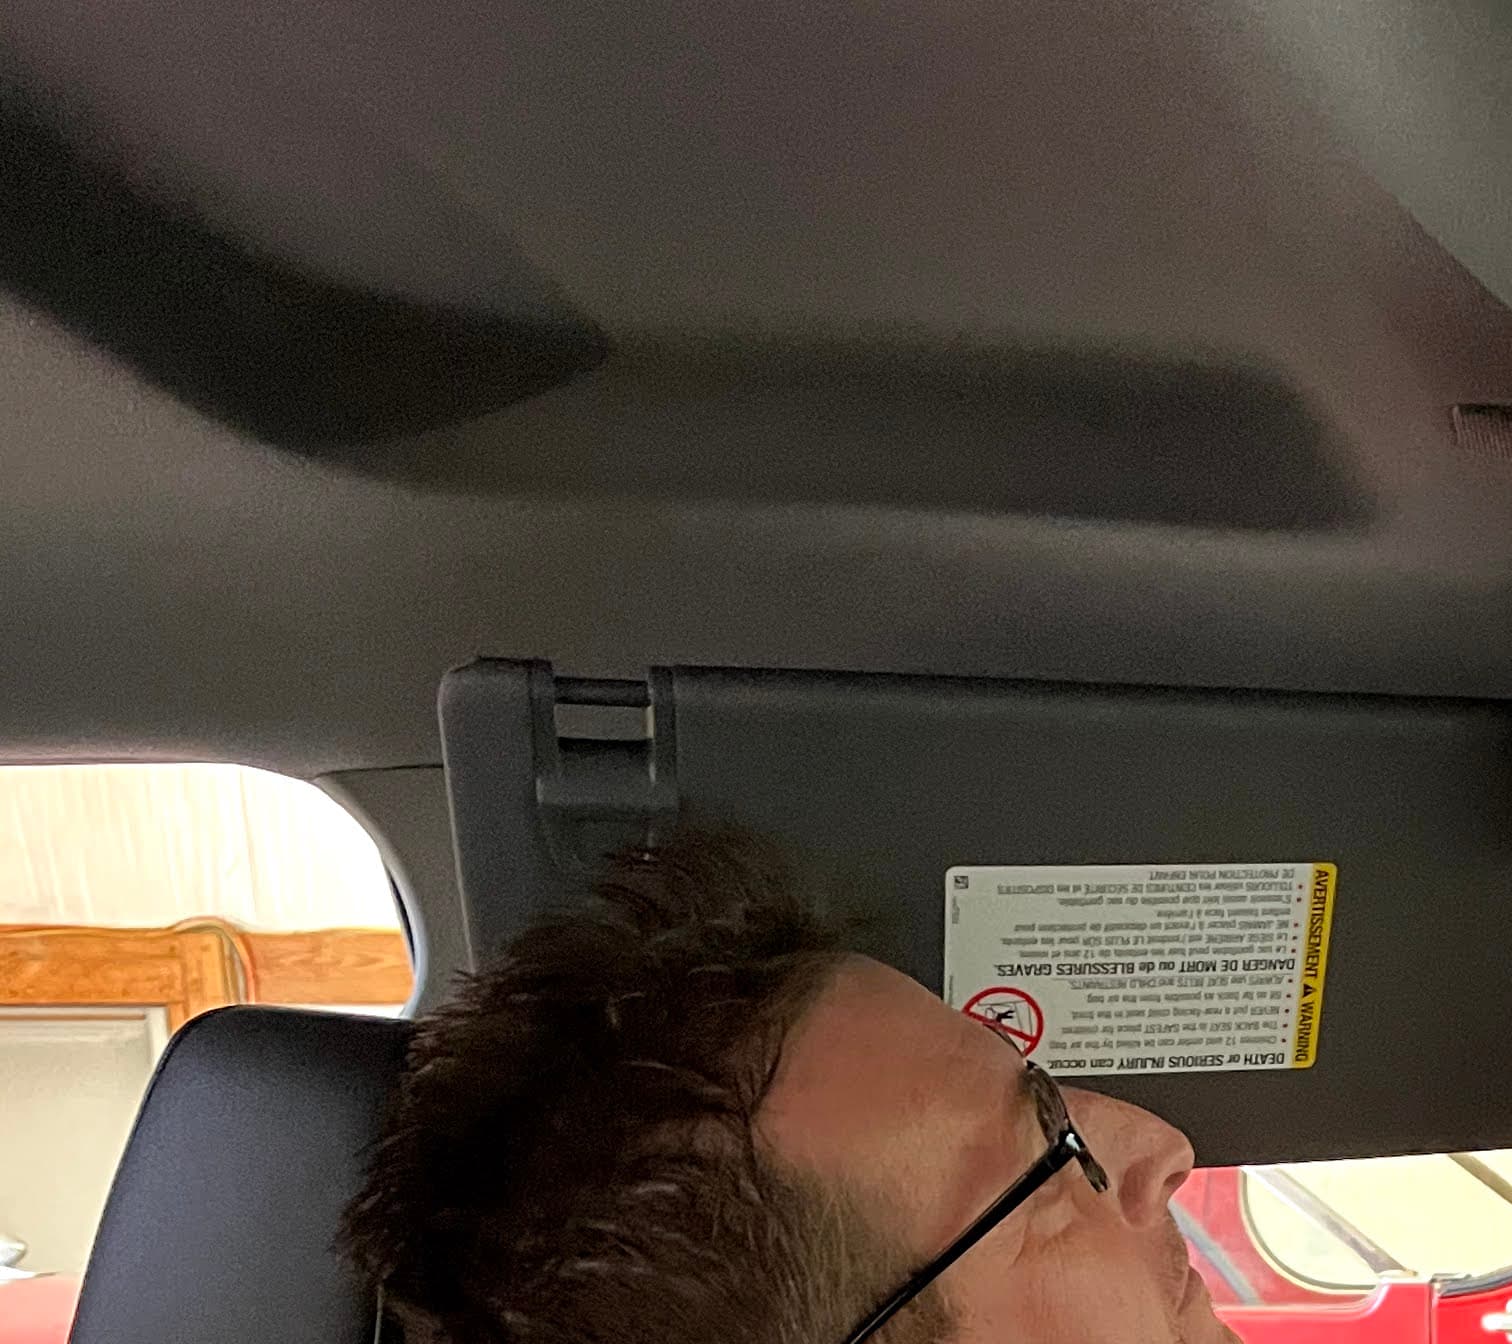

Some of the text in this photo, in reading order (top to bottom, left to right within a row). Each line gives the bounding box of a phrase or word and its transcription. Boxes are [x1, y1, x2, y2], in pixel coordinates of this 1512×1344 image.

[994, 959, 1295, 976] DANGER DE MORT ou de BLESSURES GRAVES.
[1295, 869, 1330, 1063] AVERTISSEMENT WARNING
[1226, 1037, 1236, 1045] 12
[1090, 1059, 1113, 1067] can
[1117, 1056, 1164, 1069] INJURY
[1168, 1055, 1224, 1067] SERIOUS
[1227, 1054, 1240, 1063] or
[1244, 1053, 1284, 1065] DEATH
